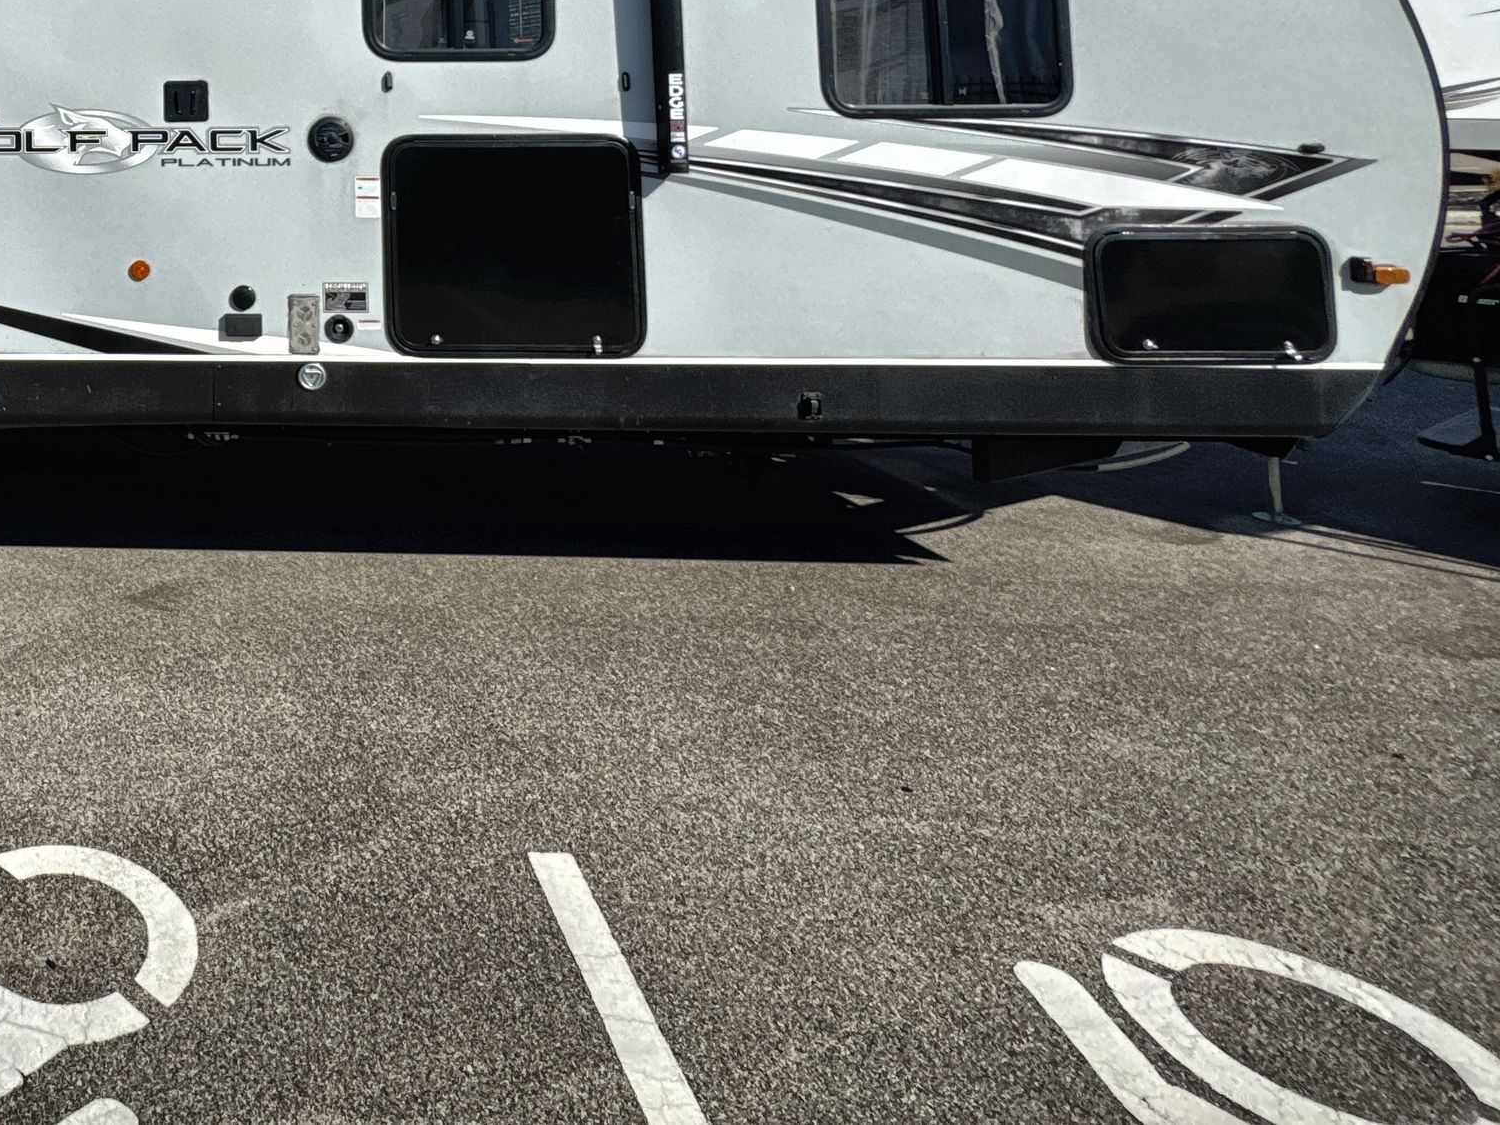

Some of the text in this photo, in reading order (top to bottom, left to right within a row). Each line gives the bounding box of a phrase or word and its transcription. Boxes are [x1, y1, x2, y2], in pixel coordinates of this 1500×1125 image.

[668, 73, 684, 120] EDGE
[126, 127, 291, 155] PACK
[161, 158, 291, 167] PLATINUM
